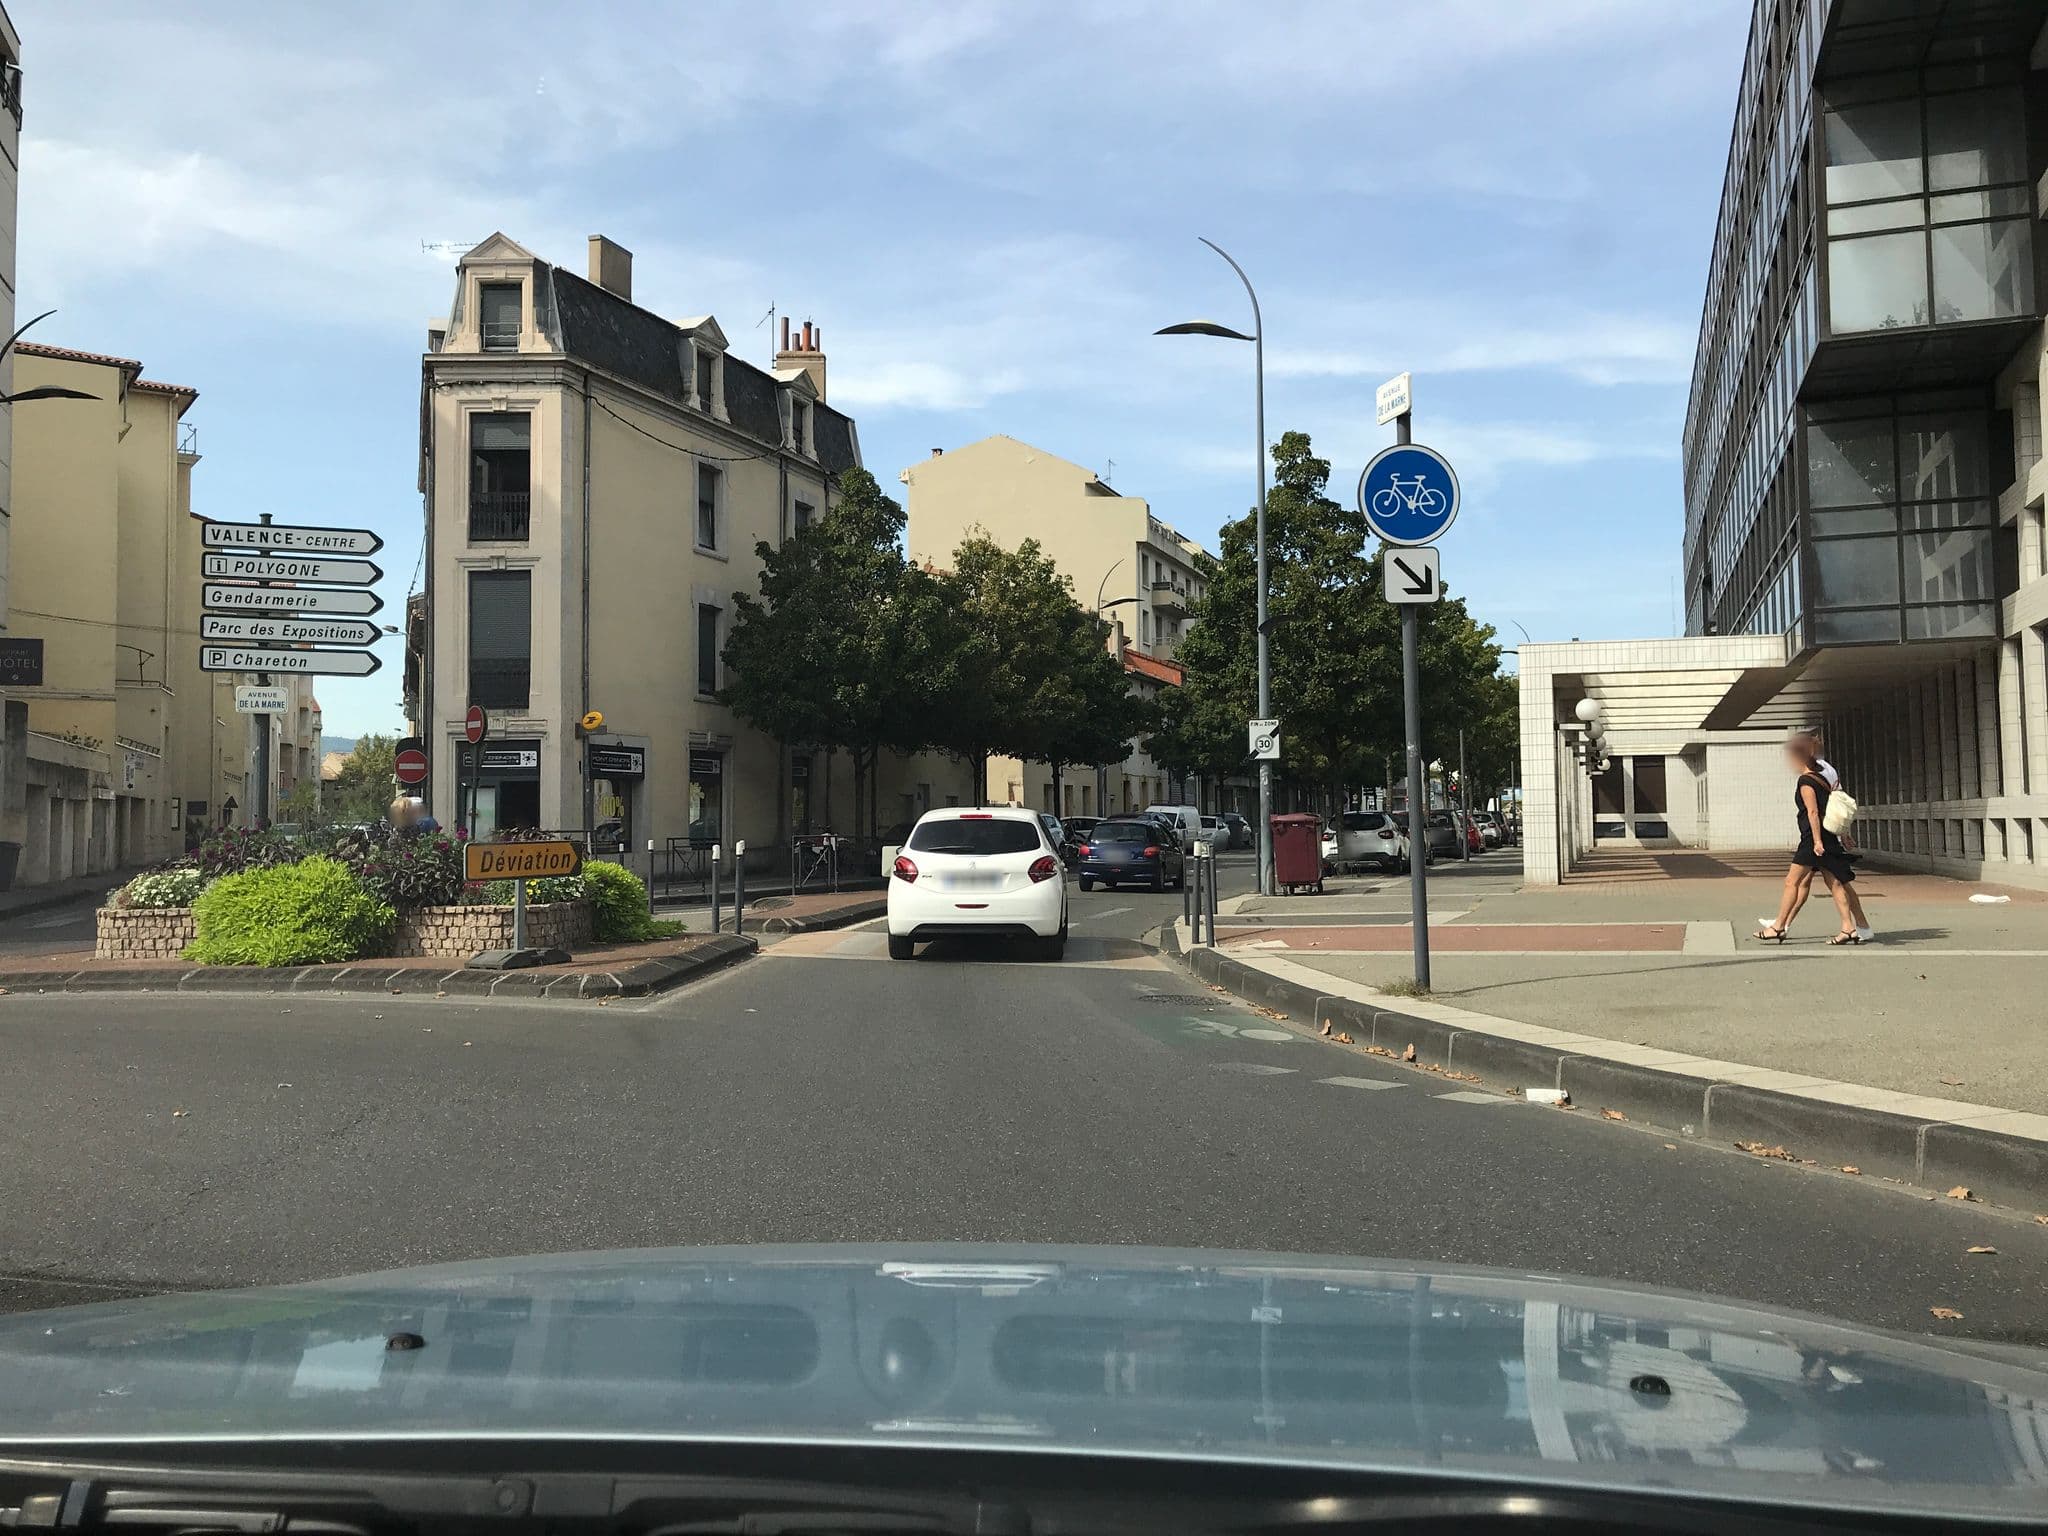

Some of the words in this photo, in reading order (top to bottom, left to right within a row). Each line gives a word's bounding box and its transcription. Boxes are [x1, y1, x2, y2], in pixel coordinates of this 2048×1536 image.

[234, 561, 320, 577] POLYGONE
[212, 591, 317, 606] Gendarmerie
[209, 621, 241, 634] Parc
[250, 623, 274, 635] des
[282, 624, 365, 640] Expositions
[0, 658, 38, 669] OTEL
[233, 653, 307, 667] Chareton
[240, 700, 249, 708] DE
[261, 701, 285, 709] MARNE
[1258, 739, 1271, 748] 30
[480, 849, 571, 873] Déviation
